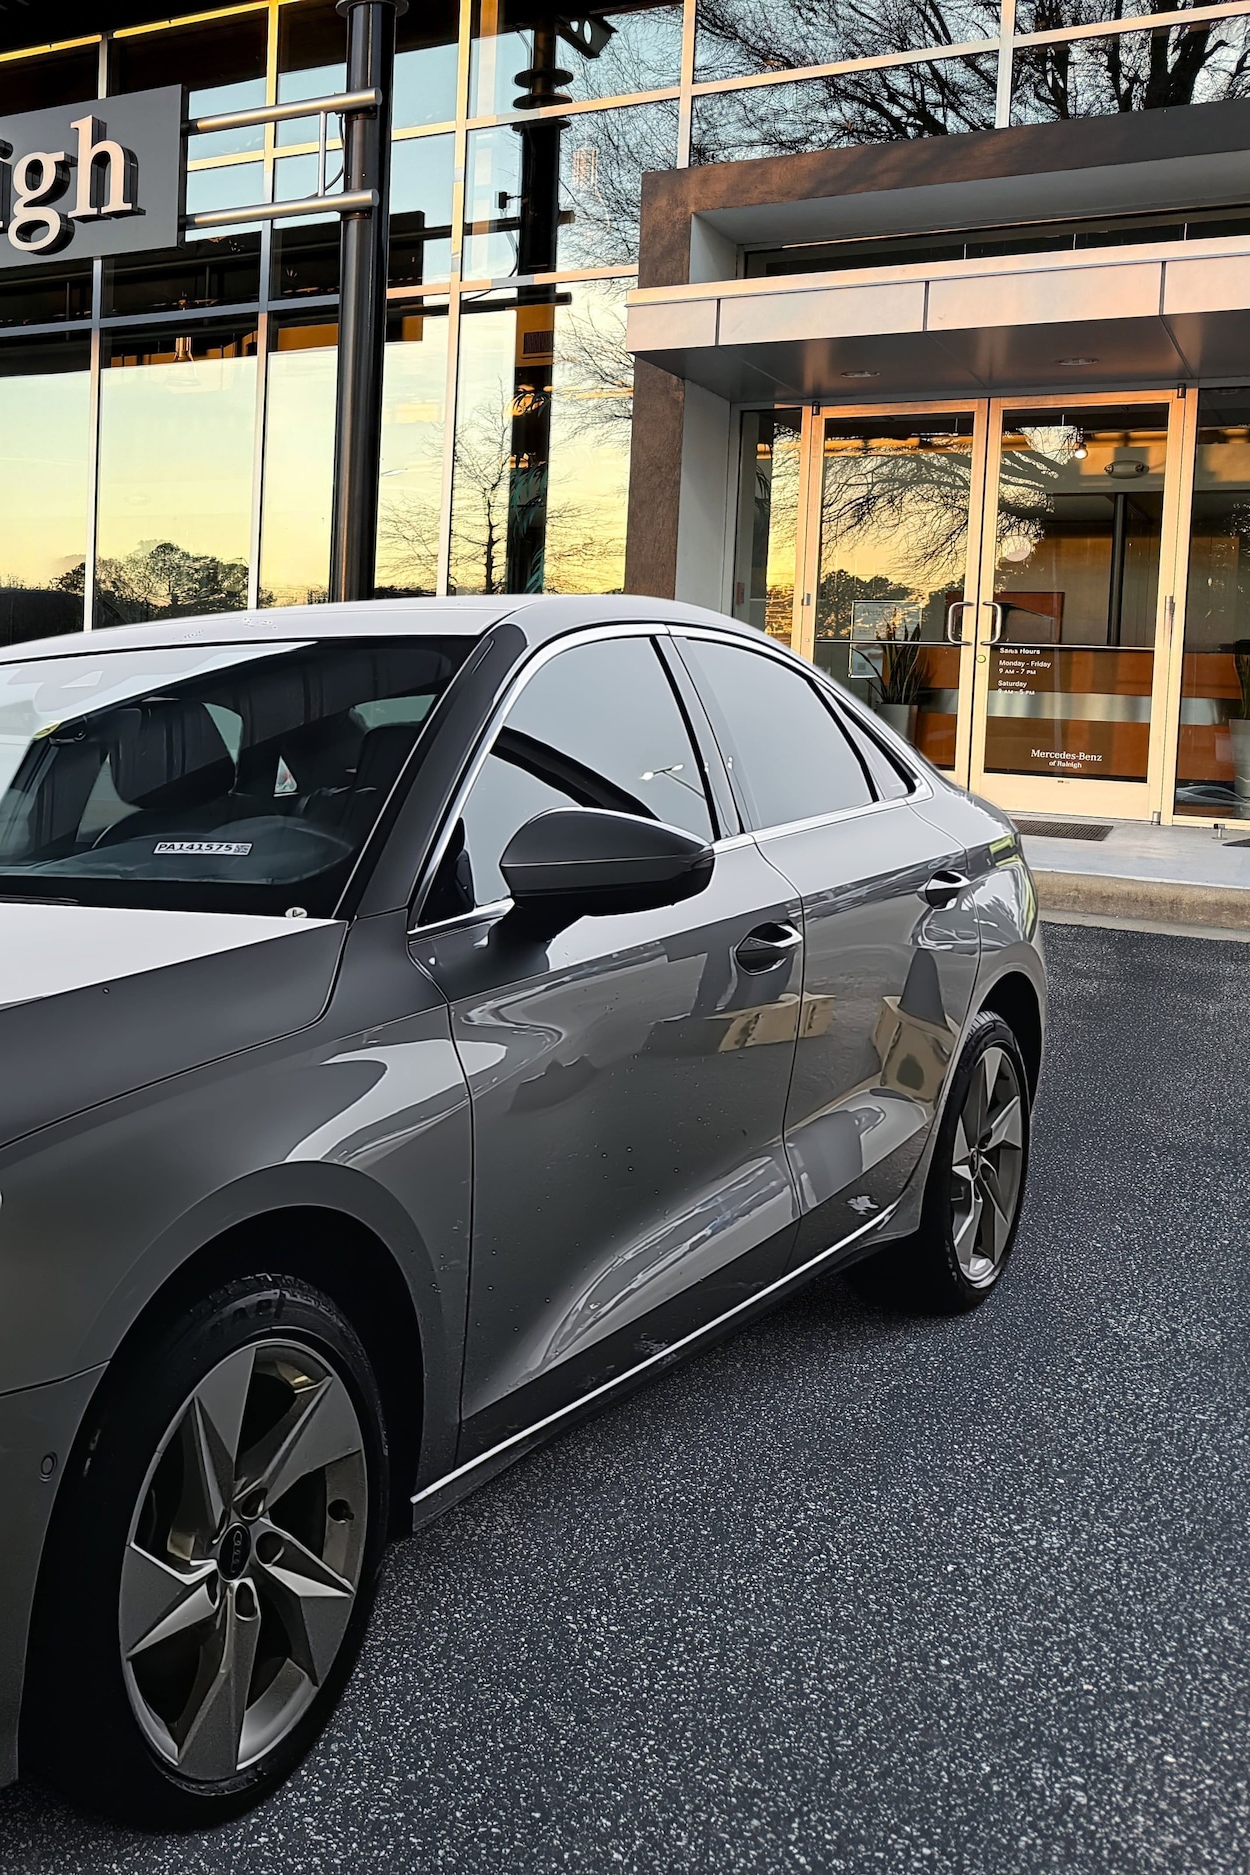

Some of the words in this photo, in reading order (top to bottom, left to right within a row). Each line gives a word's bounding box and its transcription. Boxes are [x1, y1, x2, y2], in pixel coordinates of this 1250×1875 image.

[998, 680, 1027, 688] Saturday
[1031, 749, 1102, 761] Mercedes-Benz
[1057, 761, 1082, 769] Raleigh
[157, 843, 233, 851] PA141575
